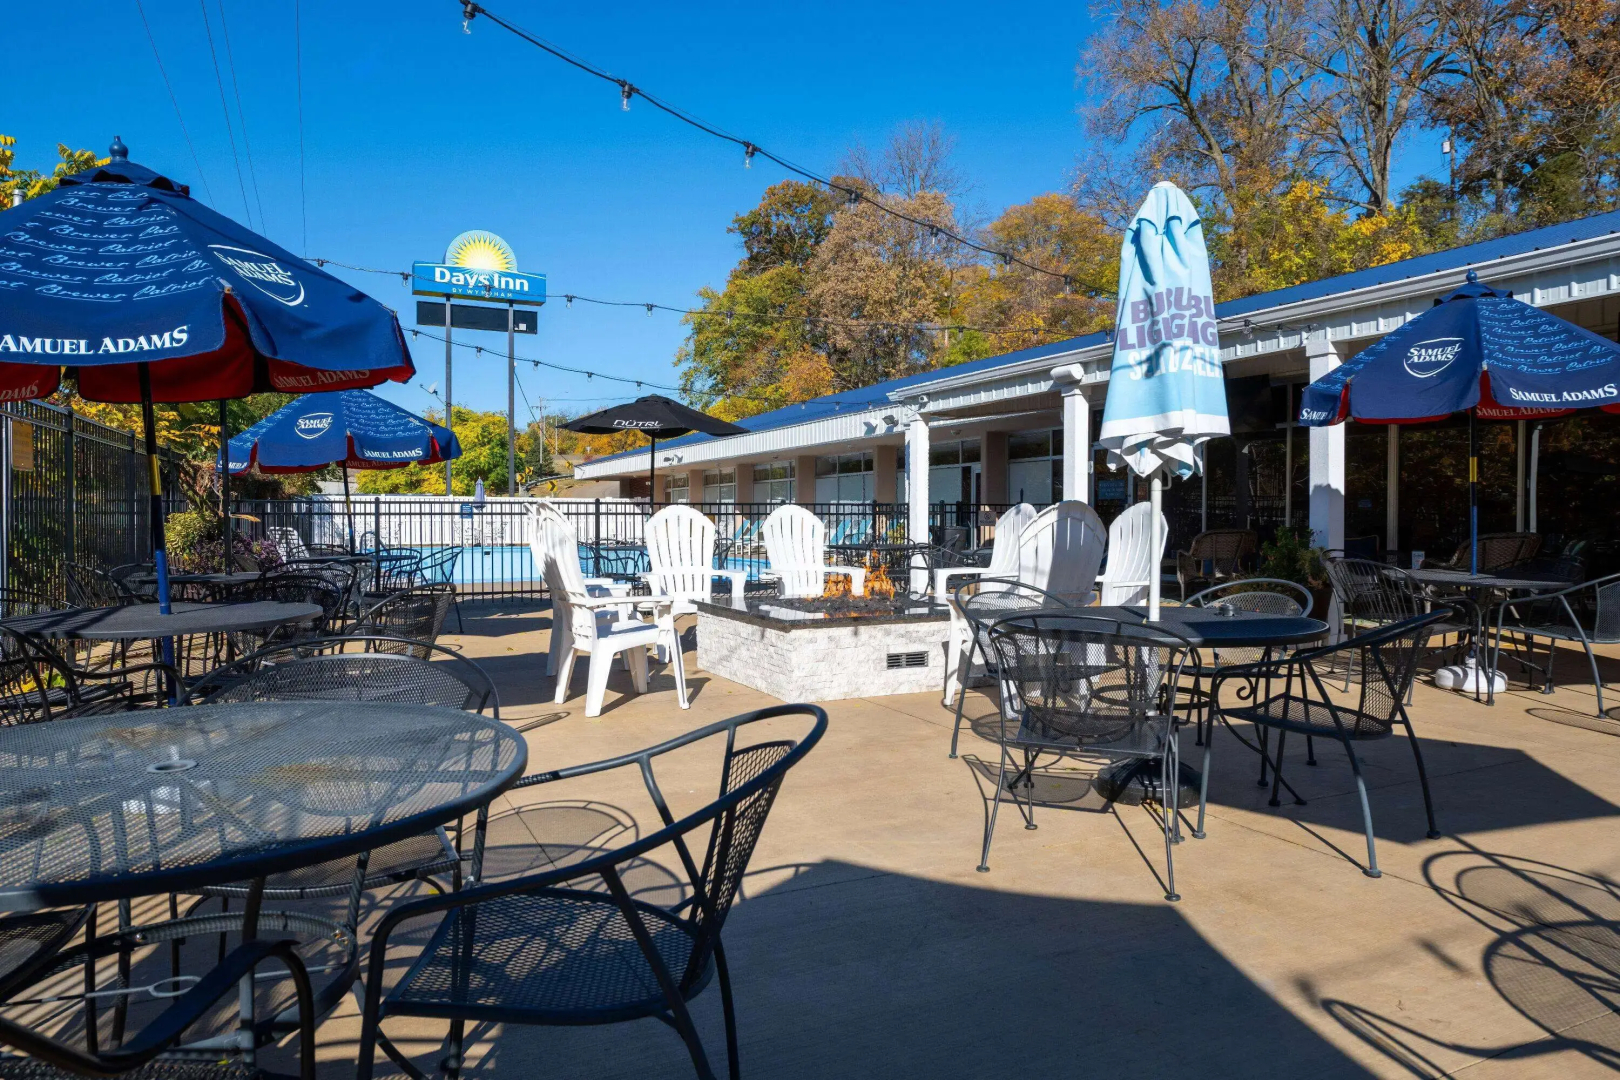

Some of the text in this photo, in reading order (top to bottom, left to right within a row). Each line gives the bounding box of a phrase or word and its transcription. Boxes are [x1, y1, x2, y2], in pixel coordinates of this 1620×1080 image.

[434, 267, 529, 292] Days Inn
[0, 325, 189, 355] AMUEL ADAMS
[1407, 342, 1462, 357] SAMUEL
[1406, 353, 1454, 364] ADAMS
[0, 380, 39, 400] DAMS
[1509, 383, 1618, 402] SAMUEL ADAMS
[1476, 404, 1518, 417] SAMUEL
[363, 443, 424, 458] SAMUEL ADAMS
